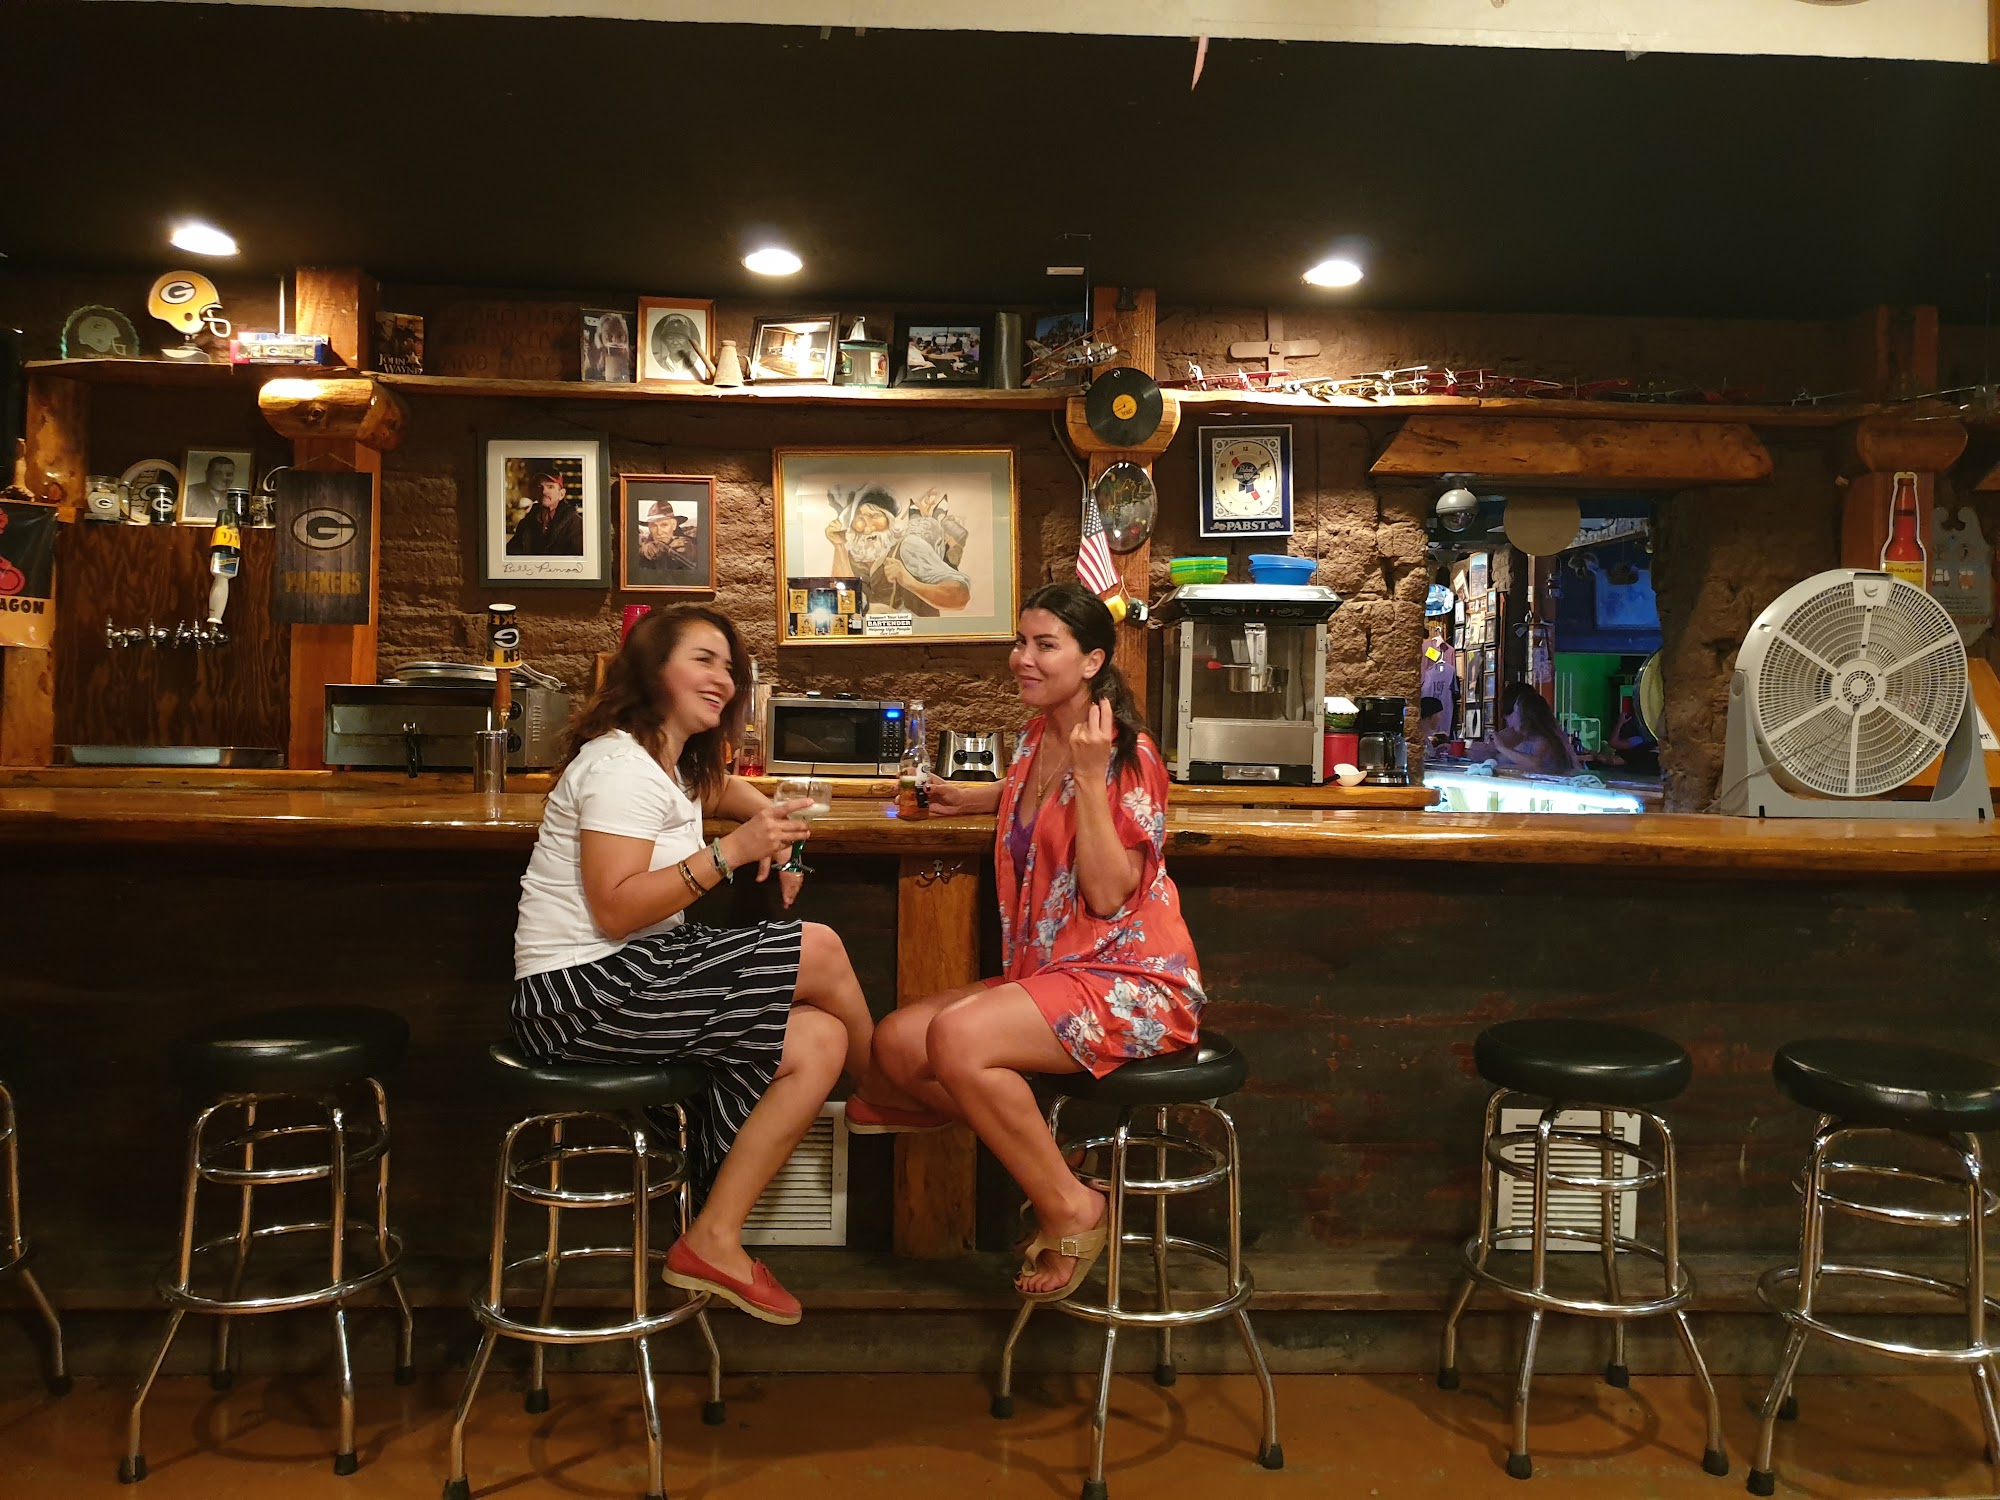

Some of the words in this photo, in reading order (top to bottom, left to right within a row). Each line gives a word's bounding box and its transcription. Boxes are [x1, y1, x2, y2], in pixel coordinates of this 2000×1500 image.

[160, 279, 196, 305] G
[379, 353, 406, 366] JOHN
[384, 363, 423, 374] WAYNE
[290, 507, 359, 550] G
[1226, 520, 1269, 531] PABST
[284, 571, 362, 595] PACKERS
